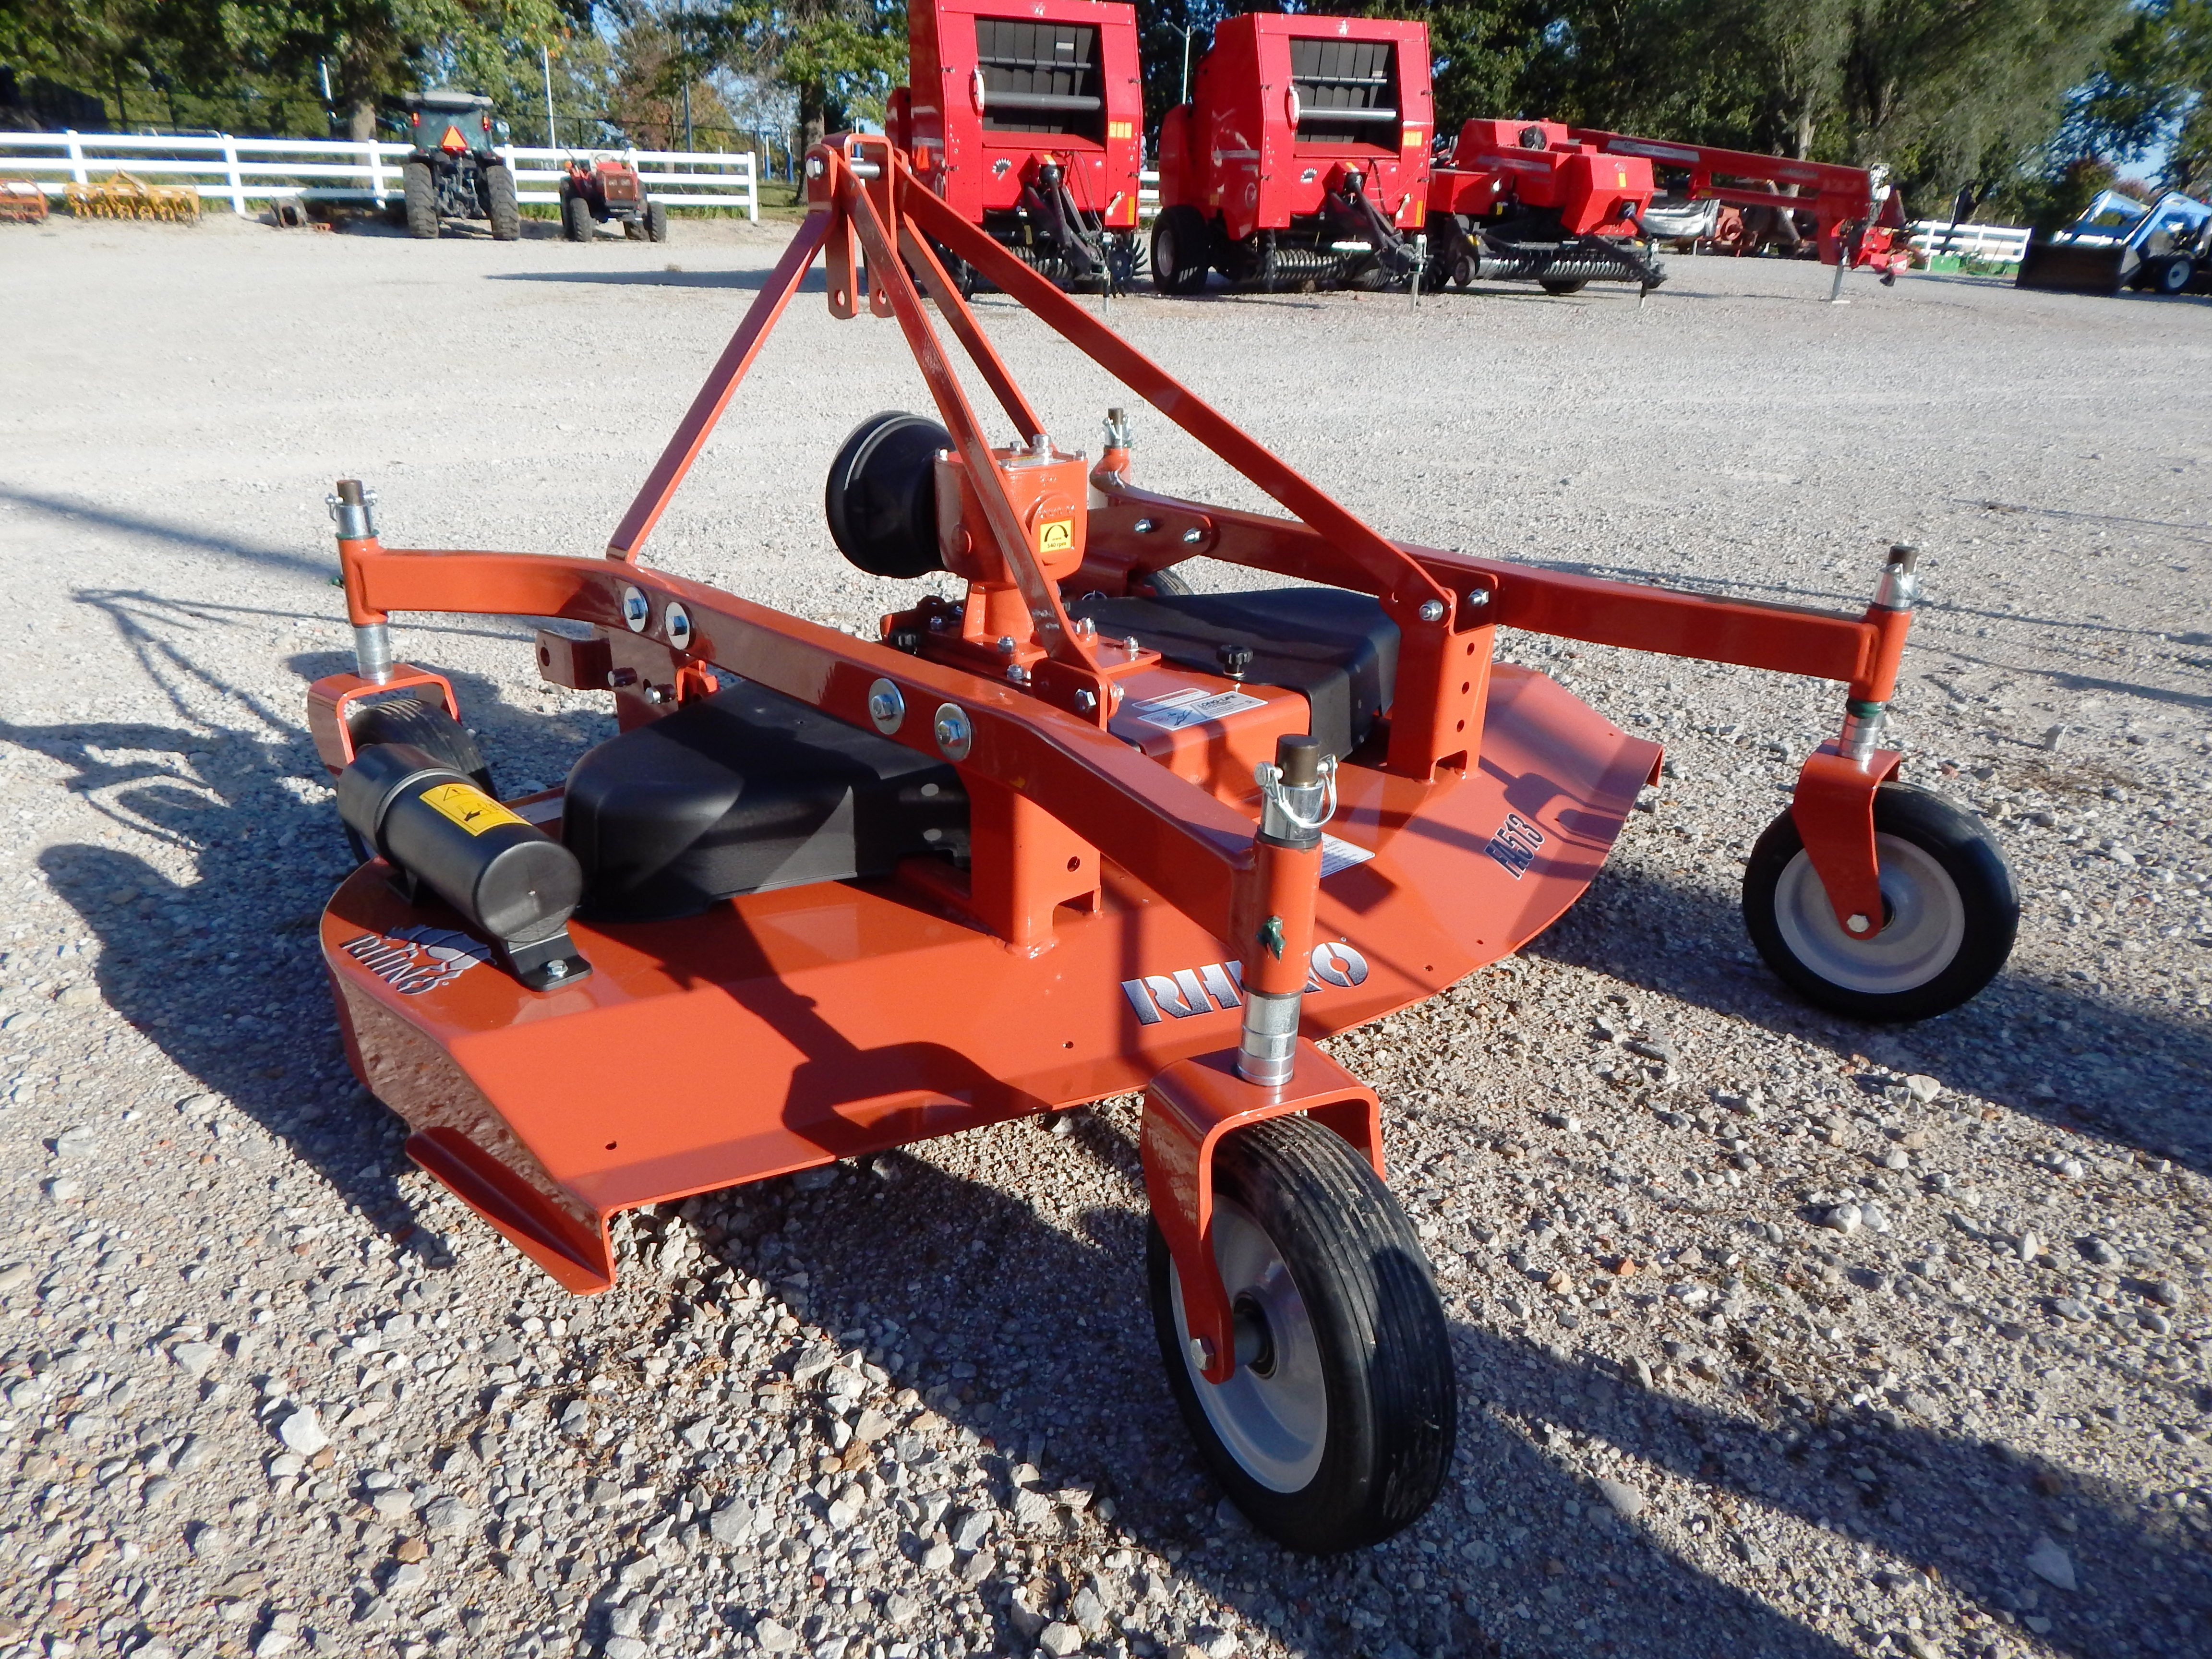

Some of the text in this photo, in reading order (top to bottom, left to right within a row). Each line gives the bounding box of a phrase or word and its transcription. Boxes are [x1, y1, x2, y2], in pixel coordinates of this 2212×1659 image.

[1483, 812, 1545, 880] FA513
[338, 933, 440, 995] RHINO
[1121, 941, 1368, 1026] RHO
